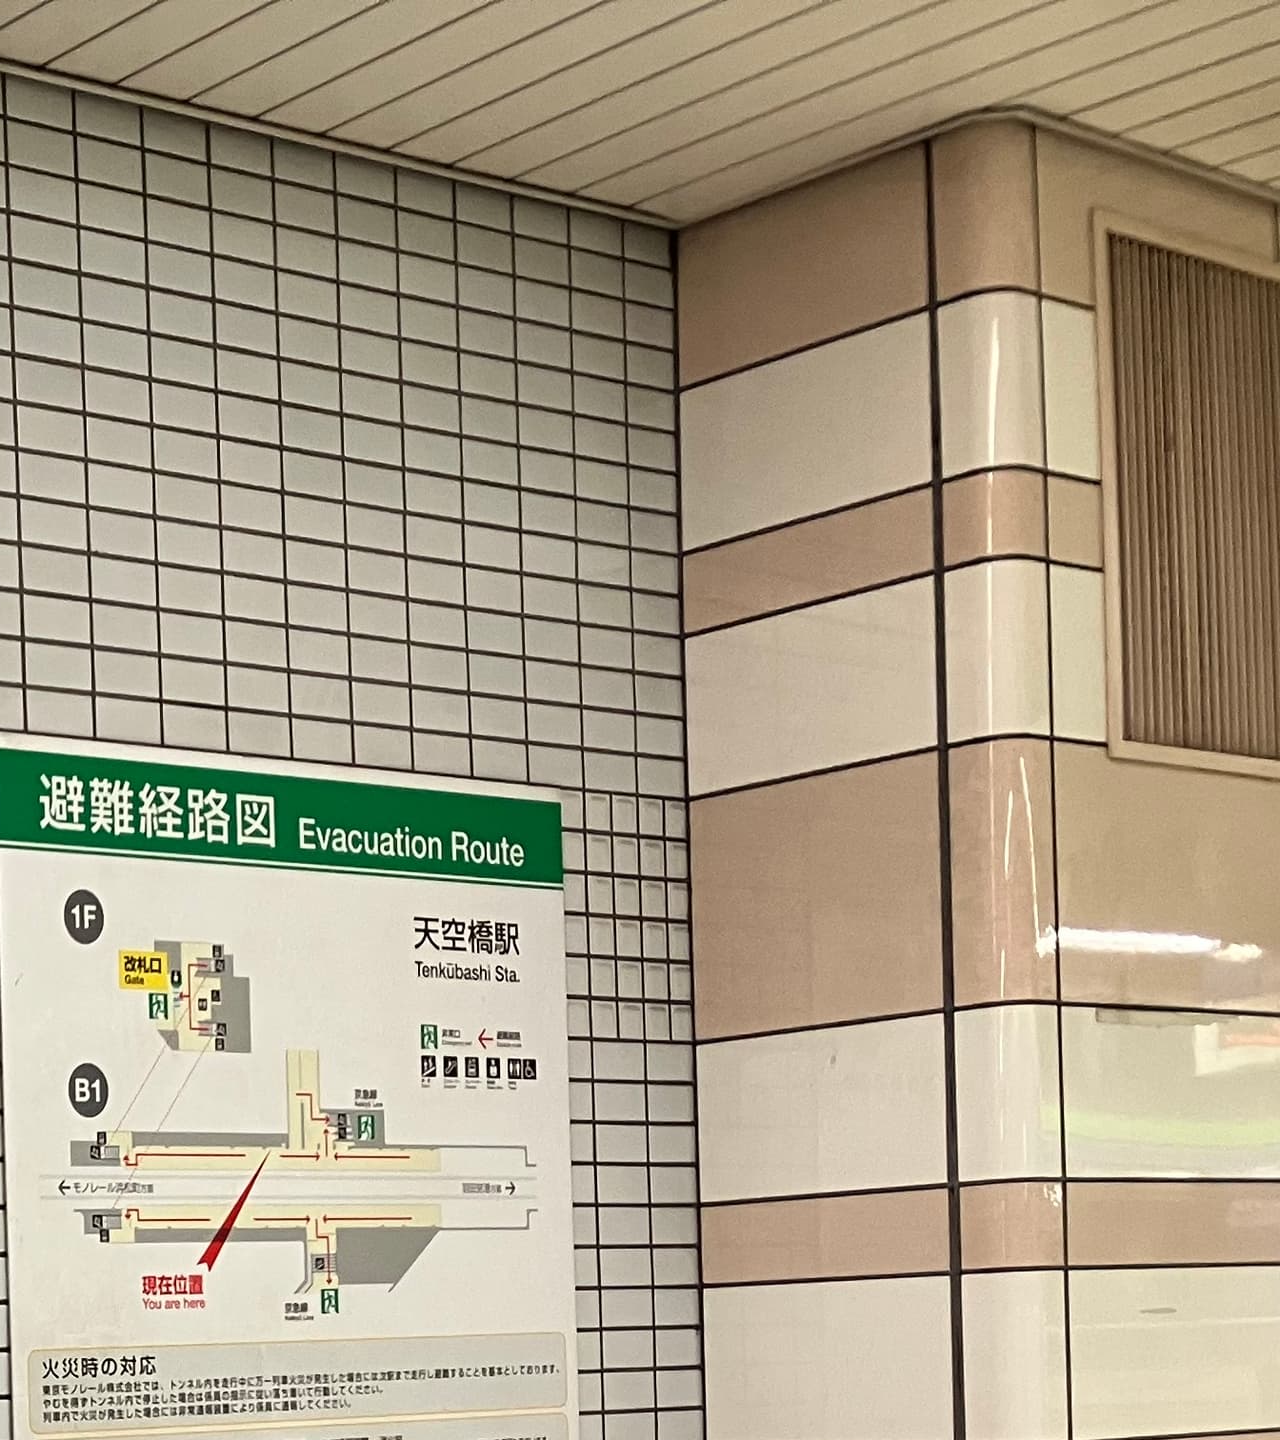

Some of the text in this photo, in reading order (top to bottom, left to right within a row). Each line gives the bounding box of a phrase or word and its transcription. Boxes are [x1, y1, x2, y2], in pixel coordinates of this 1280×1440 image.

[39, 774, 525, 867] 避難経路図 Evacuation Route
[71, 903, 97, 930] 1F
[413, 916, 520, 955] 天空橋駅
[414, 960, 520, 982] Tenkūbashi Sta.
[74, 1078, 103, 1103] B1
[142, 1275, 204, 1295] 現在位置
[142, 1298, 206, 1310] You are here
[42, 1356, 157, 1380] 火災時の対応
